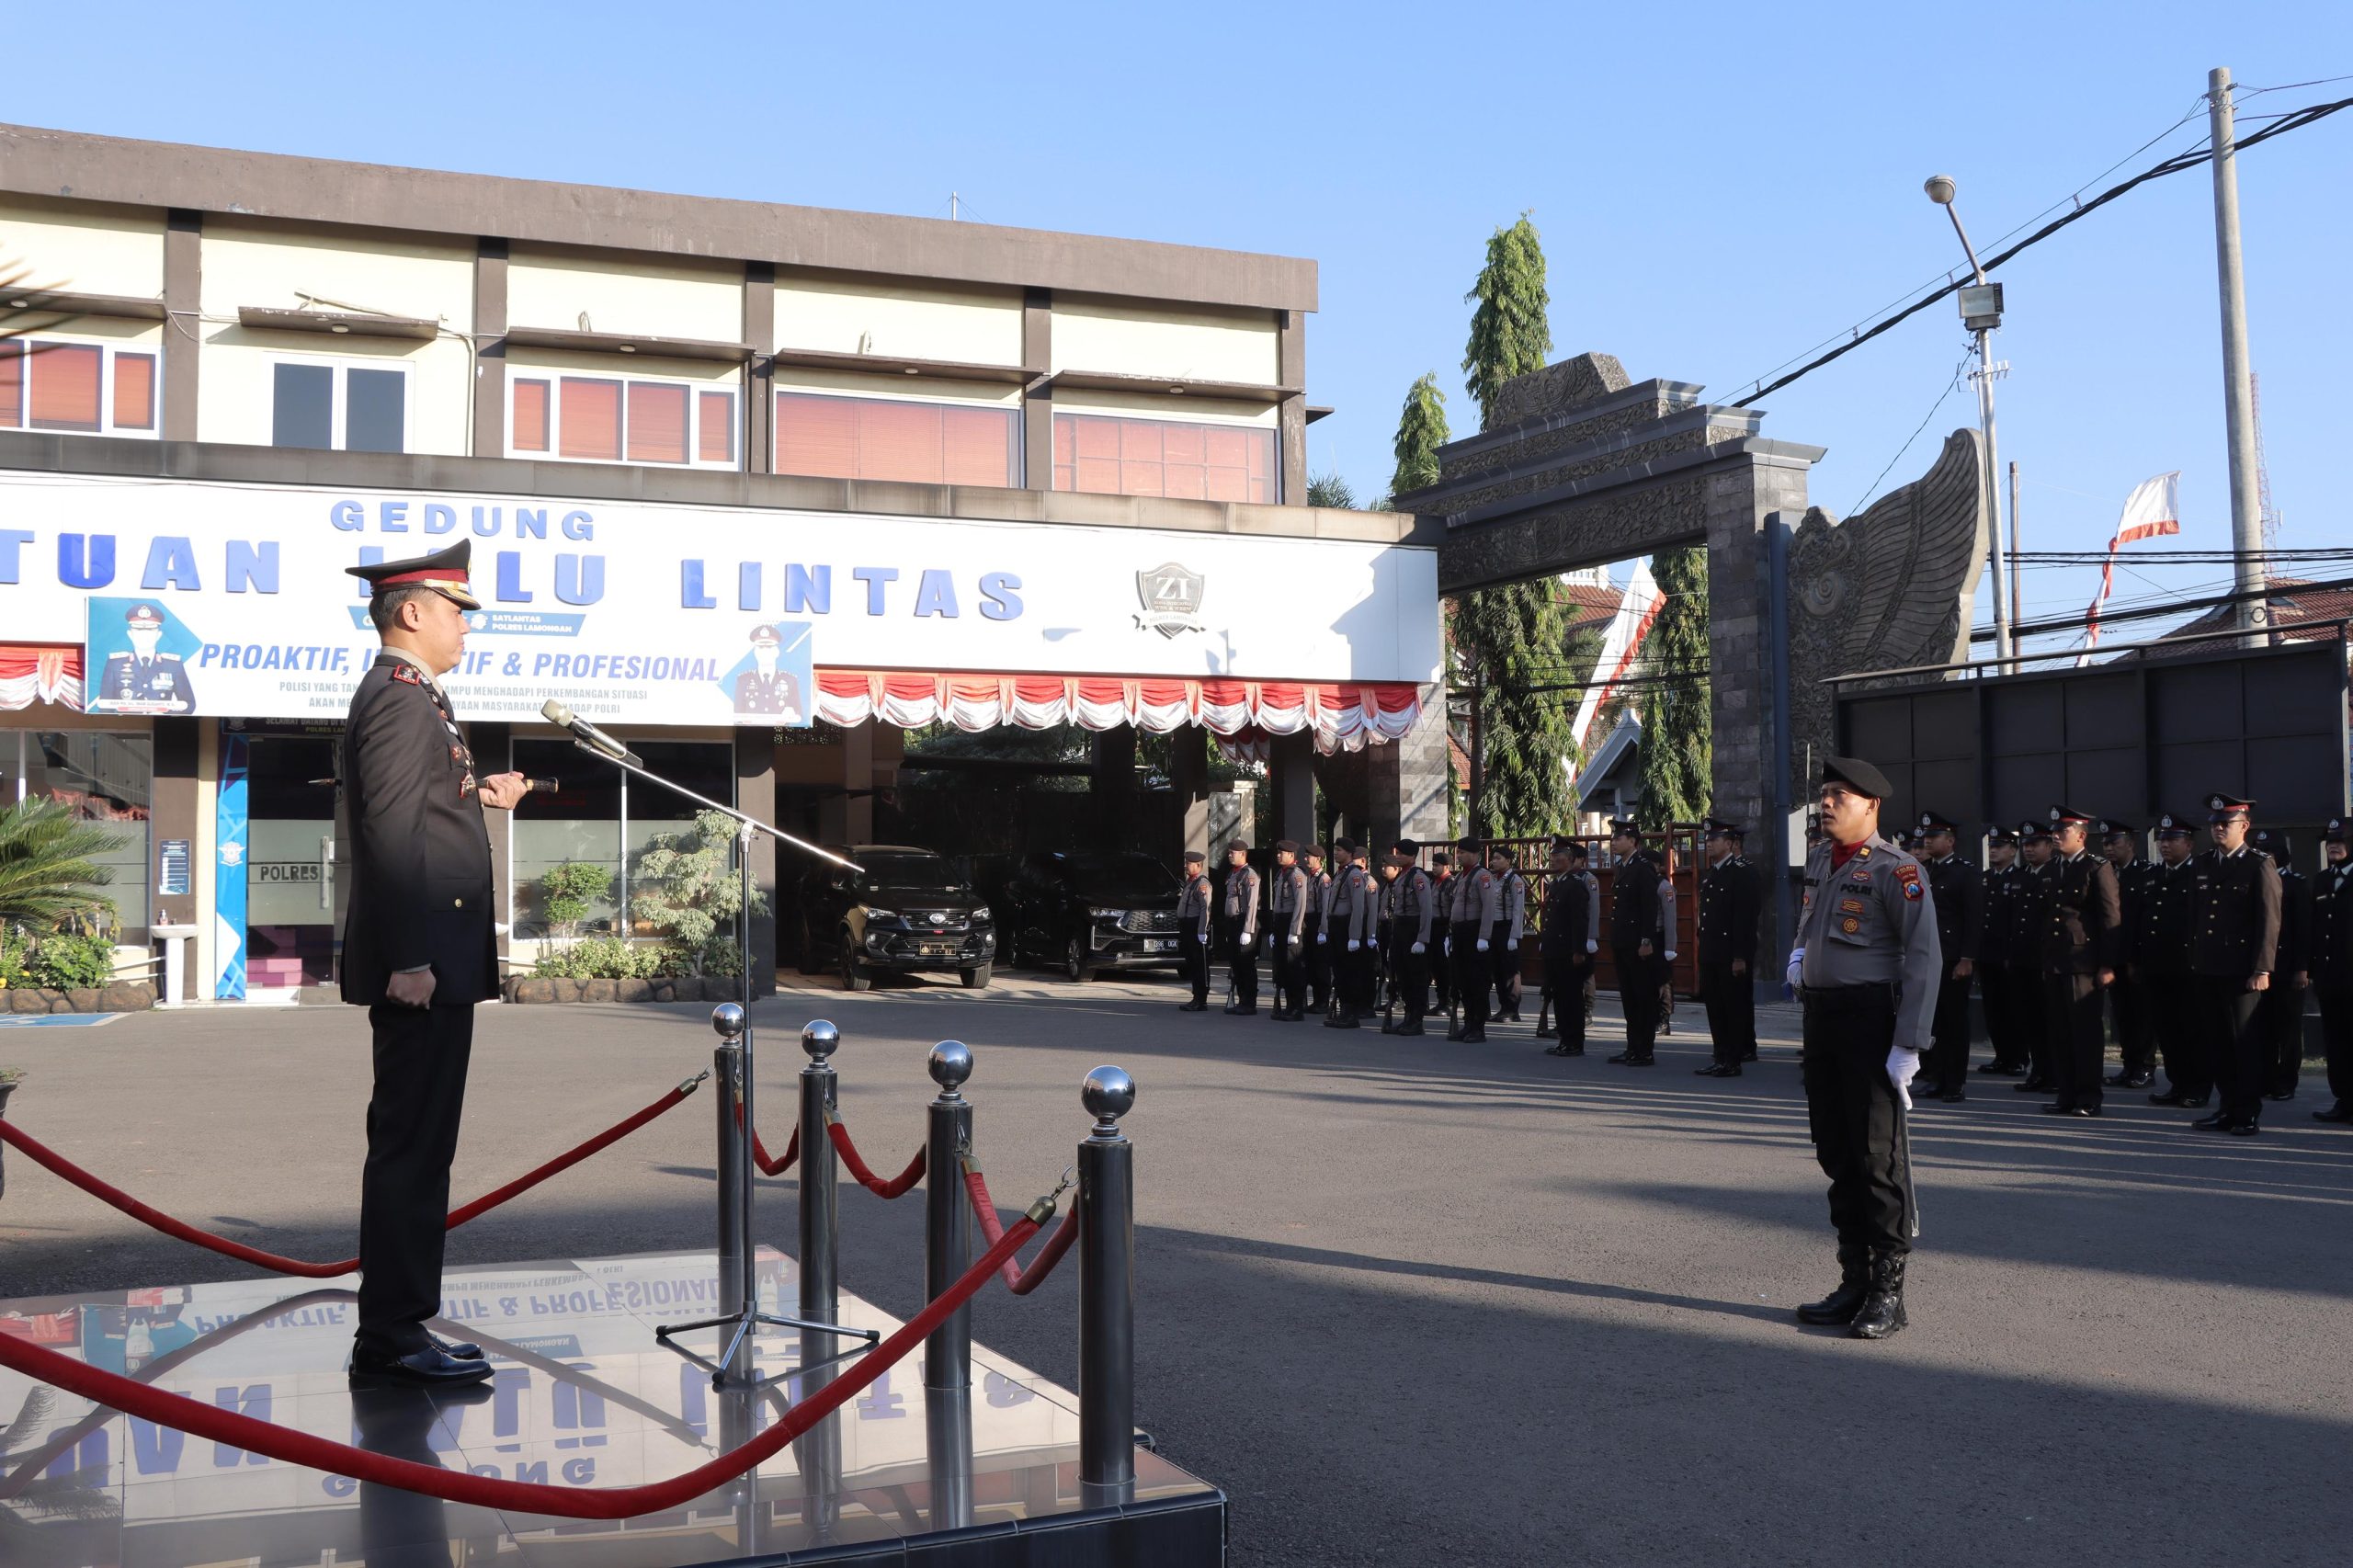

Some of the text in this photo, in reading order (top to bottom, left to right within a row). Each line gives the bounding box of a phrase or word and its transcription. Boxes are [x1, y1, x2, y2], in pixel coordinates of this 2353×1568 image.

[330, 499, 594, 540] GEDUNG
[681, 559, 1024, 621] LINTAS
[1155, 576, 1192, 600] ZI
[492, 614, 540, 622] SATLANTAS
[492, 623, 573, 632] POLRES LAMONGAN
[199, 643, 349, 676] PROAKTIF,
[502, 652, 522, 676] &
[533, 653, 720, 681] PROFESIONAL
[279, 681, 311, 692] POLISI
[313, 682, 338, 693] YANG
[473, 687, 533, 697] MENGHADAPI
[537, 687, 609, 699] PERKEMBANGAN
[612, 689, 647, 699] SITUASI
[309, 698, 335, 708] AKAN
[482, 700, 542, 712] MASYARAKAT
[595, 704, 620, 713] POLRI
[260, 865, 318, 881] POLRES
[1840, 883, 1872, 896] POLRI
